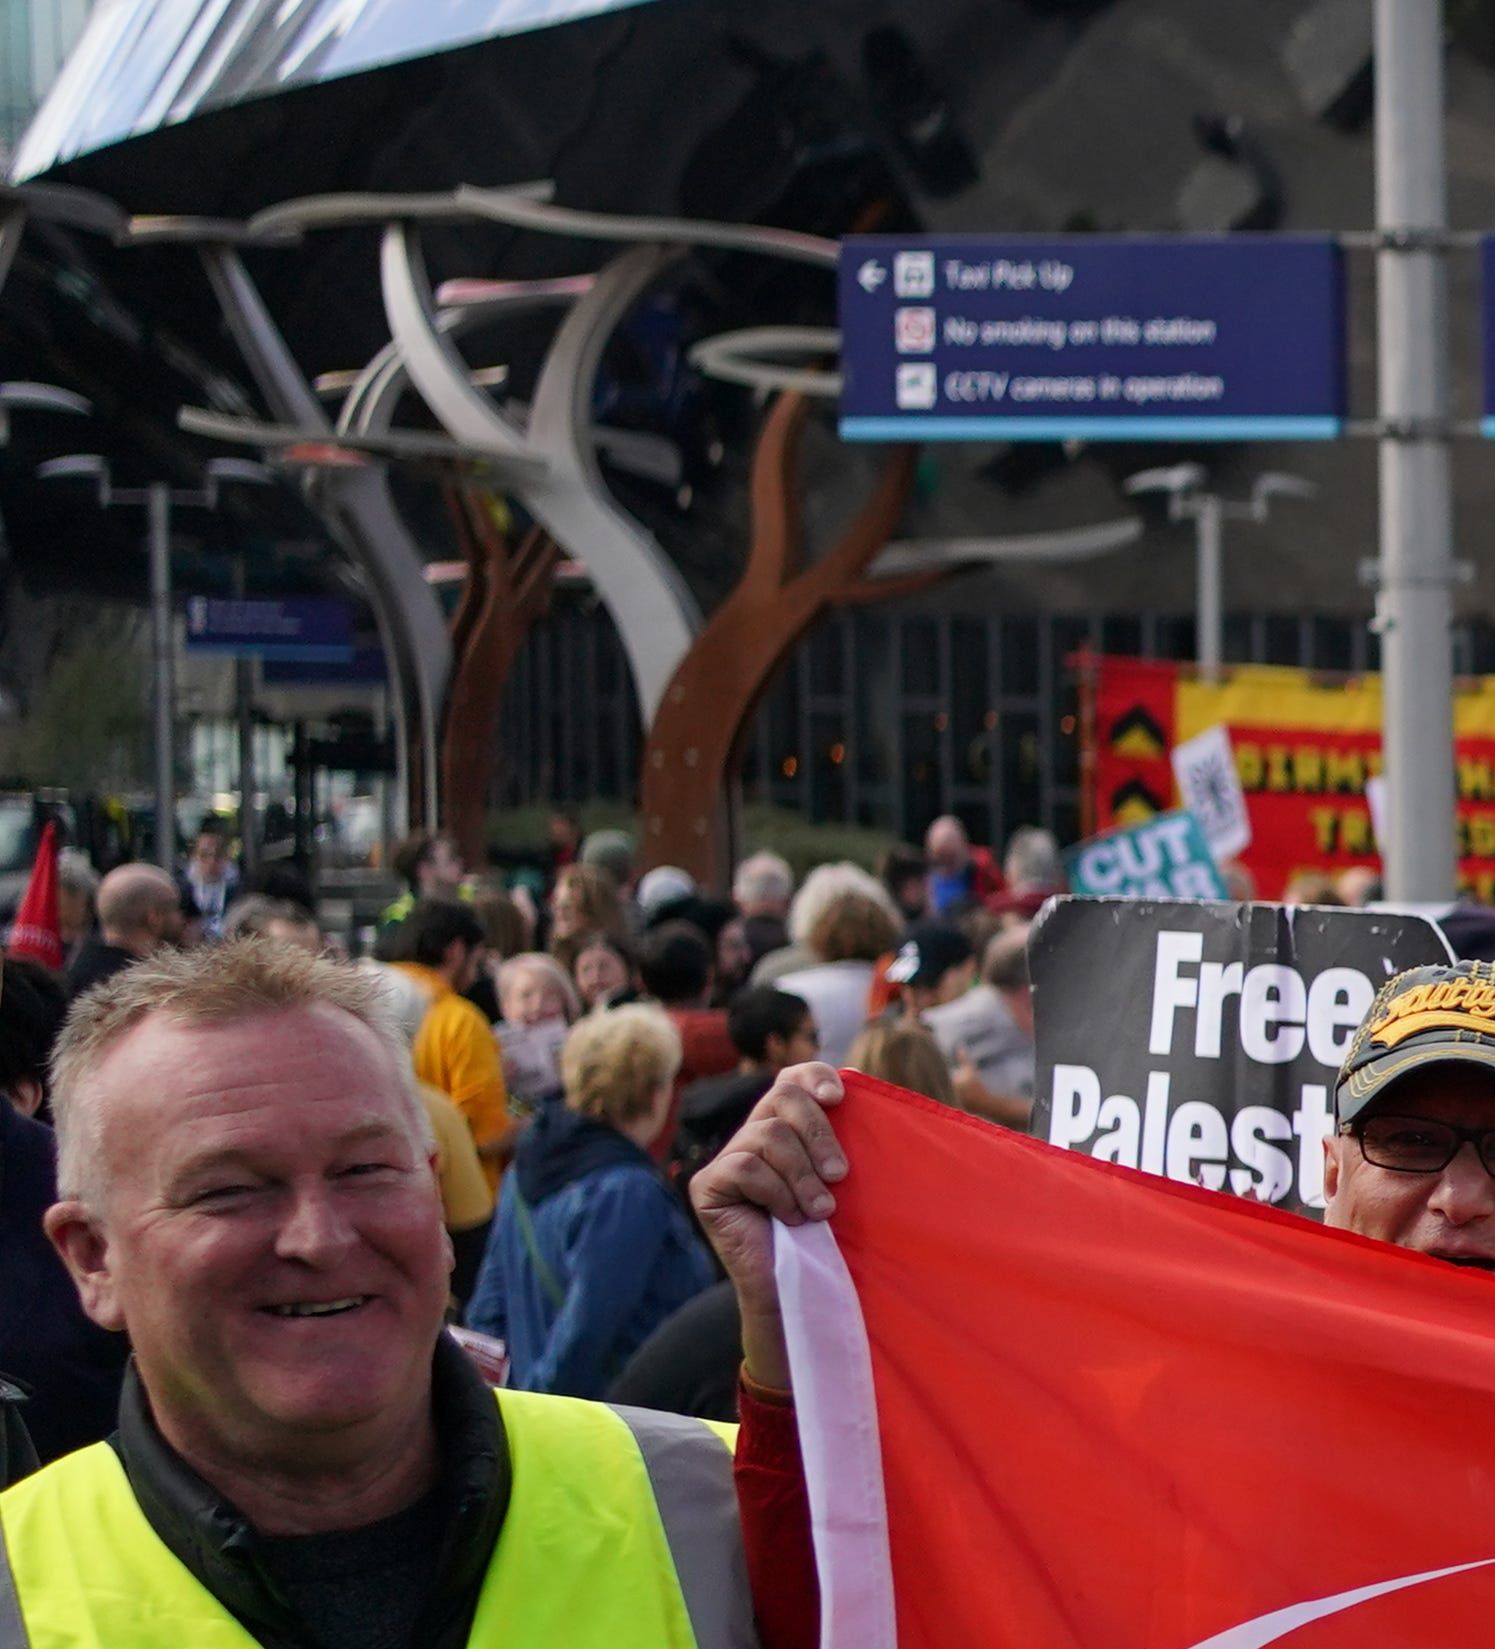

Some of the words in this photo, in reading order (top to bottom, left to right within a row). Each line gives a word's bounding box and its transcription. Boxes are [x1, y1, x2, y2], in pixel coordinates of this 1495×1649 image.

[945, 260, 989, 290] Taxi
[992, 260, 1036, 290] Pick
[1040, 260, 1073, 293] Up
[944, 318, 977, 345] No
[981, 318, 1066, 349] smoking
[1069, 322, 1096, 345] on
[1099, 317, 1139, 345] this
[1143, 317, 1217, 345] station
[944, 371, 1008, 401] CCTV
[1010, 377, 1096, 401] cameras
[1099, 372, 1121, 400] in
[1123, 372, 1224, 405] operation
[1079, 819, 1191, 891] CUT
[1149, 930, 1377, 1068] Free
[1050, 1064, 1336, 1209] Palest
